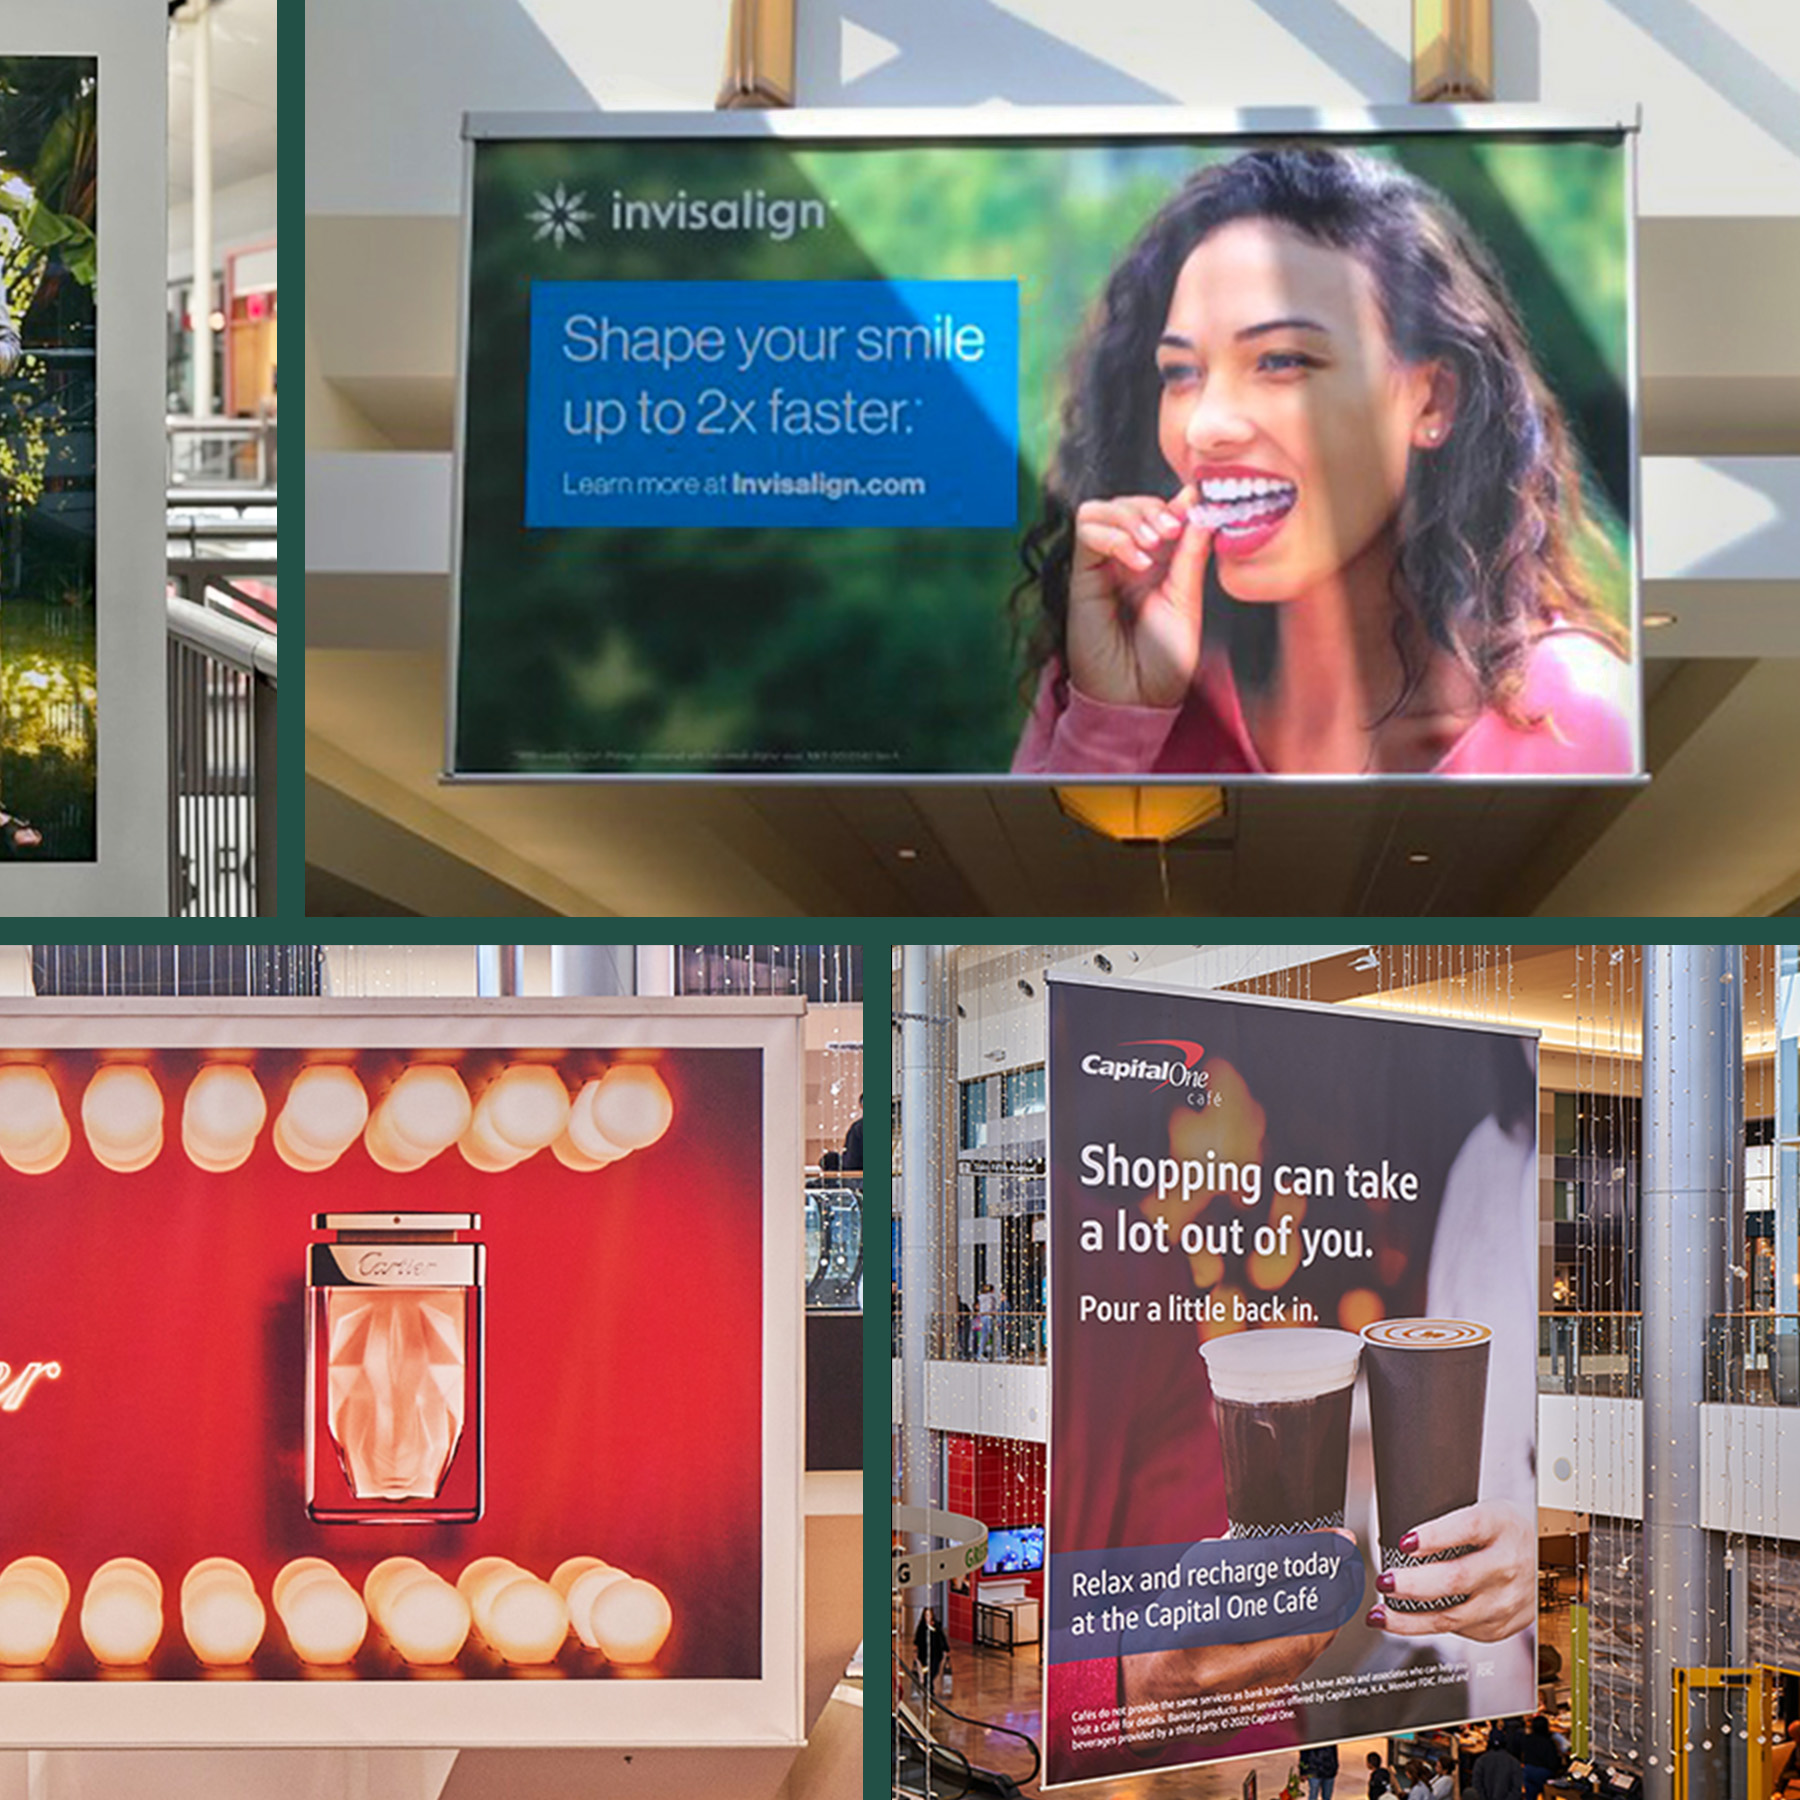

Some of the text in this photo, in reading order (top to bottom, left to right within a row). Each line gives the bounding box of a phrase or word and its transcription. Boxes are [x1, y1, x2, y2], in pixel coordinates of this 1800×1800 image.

[611, 190, 826, 240] invisalign
[563, 314, 985, 372] Shape your smile
[564, 399, 627, 444] up
[639, 390, 685, 435] to
[696, 388, 757, 435] 2x
[563, 472, 925, 501] Learn more at Invisalign.com
[1080, 1143, 1418, 1205] Shopping can take
[1080, 1209, 1373, 1267] a lot out of you.
[1080, 1295, 1319, 1322] Pour a little back in.
[1072, 1551, 1341, 1597] Relax and recharge today
[1071, 1587, 1318, 1635] at the Capital One Café
[1072, 1709, 1097, 1722] Cafés
[1098, 1708, 1110, 1719] do
[1112, 1707, 1126, 1717] not
[1128, 1702, 1159, 1717] provide
[1161, 1700, 1174, 1710] the
[1200, 1693, 1232, 1705] services
[1315, 1679, 1334, 1689] have
[1358, 1673, 1371, 1683] and
[1425, 1665, 1437, 1675] can
[1072, 1724, 1092, 1736] Visit
[1101, 1719, 1120, 1732] Café
[1122, 1718, 1134, 1729] for
[1202, 1706, 1238, 1720] products
[1240, 1702, 1255, 1713] and
[1256, 1699, 1286, 1711] services
[1315, 1692, 1324, 1704] by
[1326, 1687, 1352, 1702] Capital
[1456, 1672, 1469, 1682] and
[1072, 1736, 1116, 1751] beverages
[1118, 1728, 1155, 1745] provided
[1156, 1727, 1166, 1740] by
[1175, 1723, 1195, 1735] third
[1251, 1711, 1278, 1725] Capital
